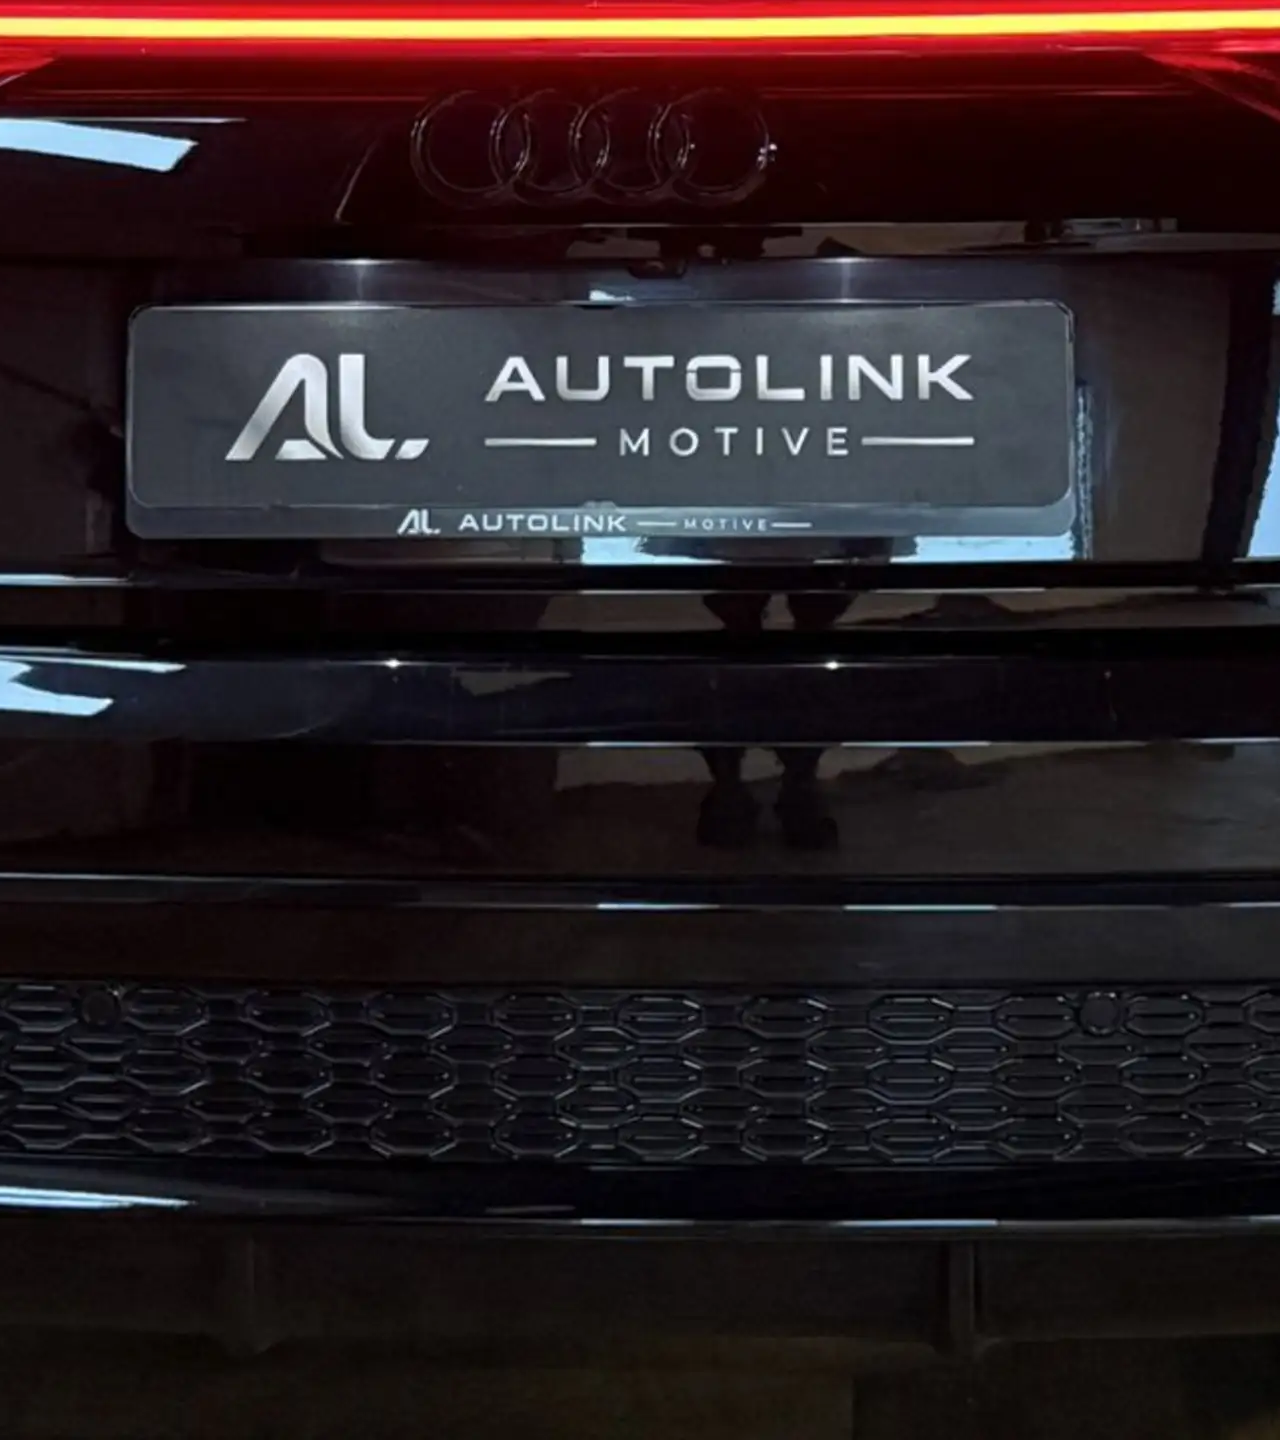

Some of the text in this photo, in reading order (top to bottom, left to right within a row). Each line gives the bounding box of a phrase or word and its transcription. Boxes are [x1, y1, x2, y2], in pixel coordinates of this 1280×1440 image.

[484, 353, 975, 403] AUTOLINK
[619, 425, 851, 457] MOTIVE
[458, 513, 627, 533] AUTOLINK
[683, 517, 768, 532] MOTIVE
